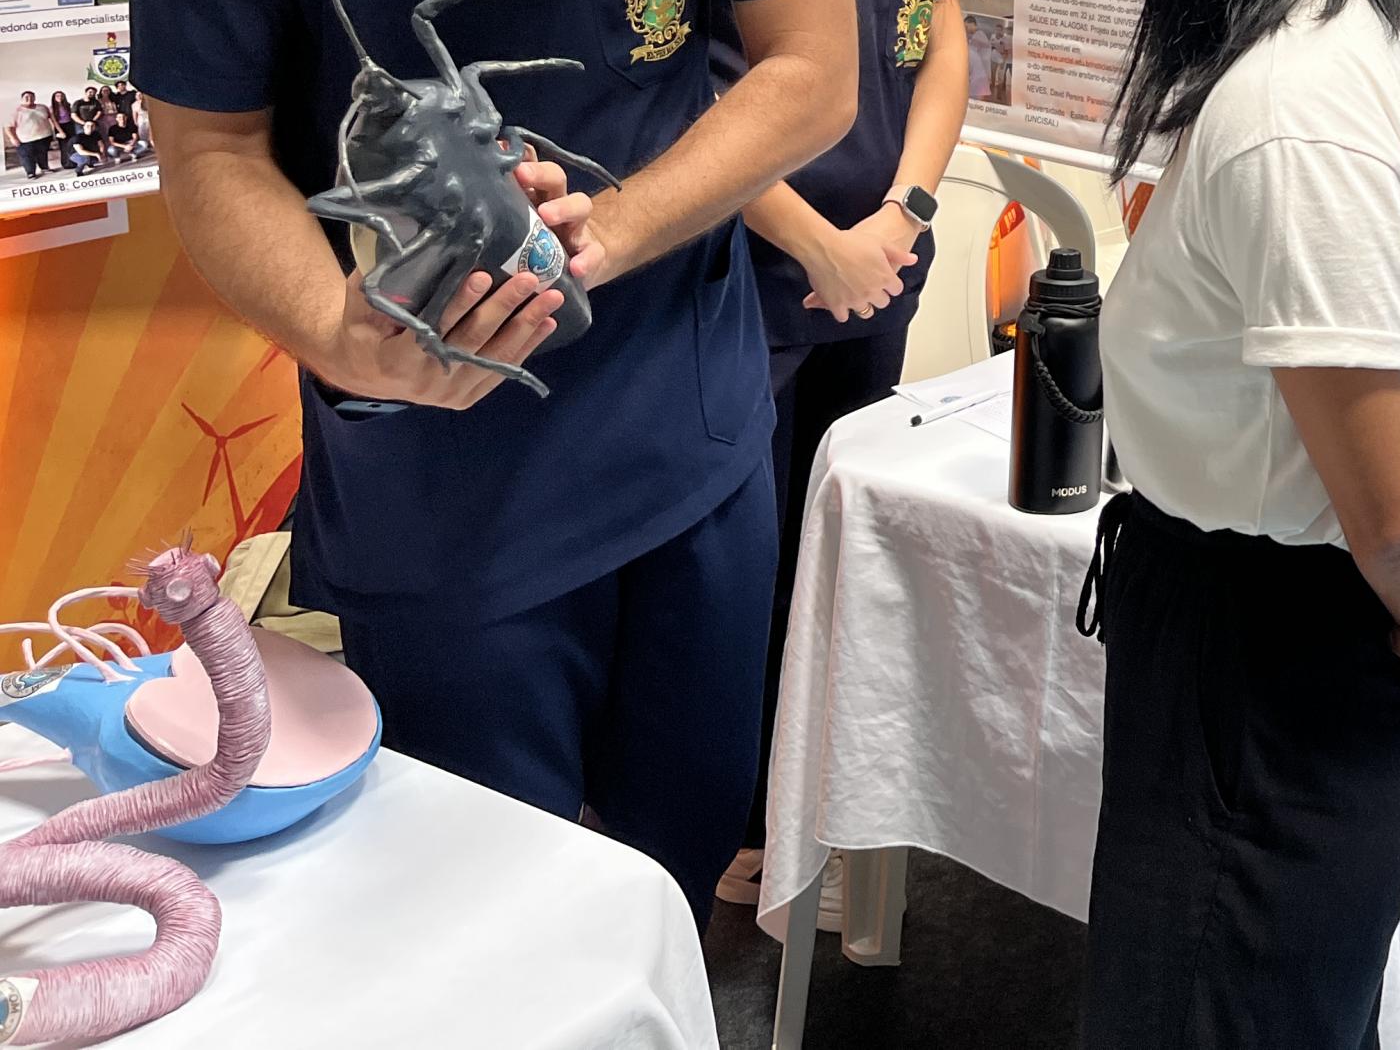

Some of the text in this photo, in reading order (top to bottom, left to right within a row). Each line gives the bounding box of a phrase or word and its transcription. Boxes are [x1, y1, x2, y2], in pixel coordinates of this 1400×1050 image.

[42, 20, 63, 30] com
[12, 182, 57, 199] FIGURA
[72, 170, 144, 190] Coordenação
[1051, 484, 1088, 498] MODUS
